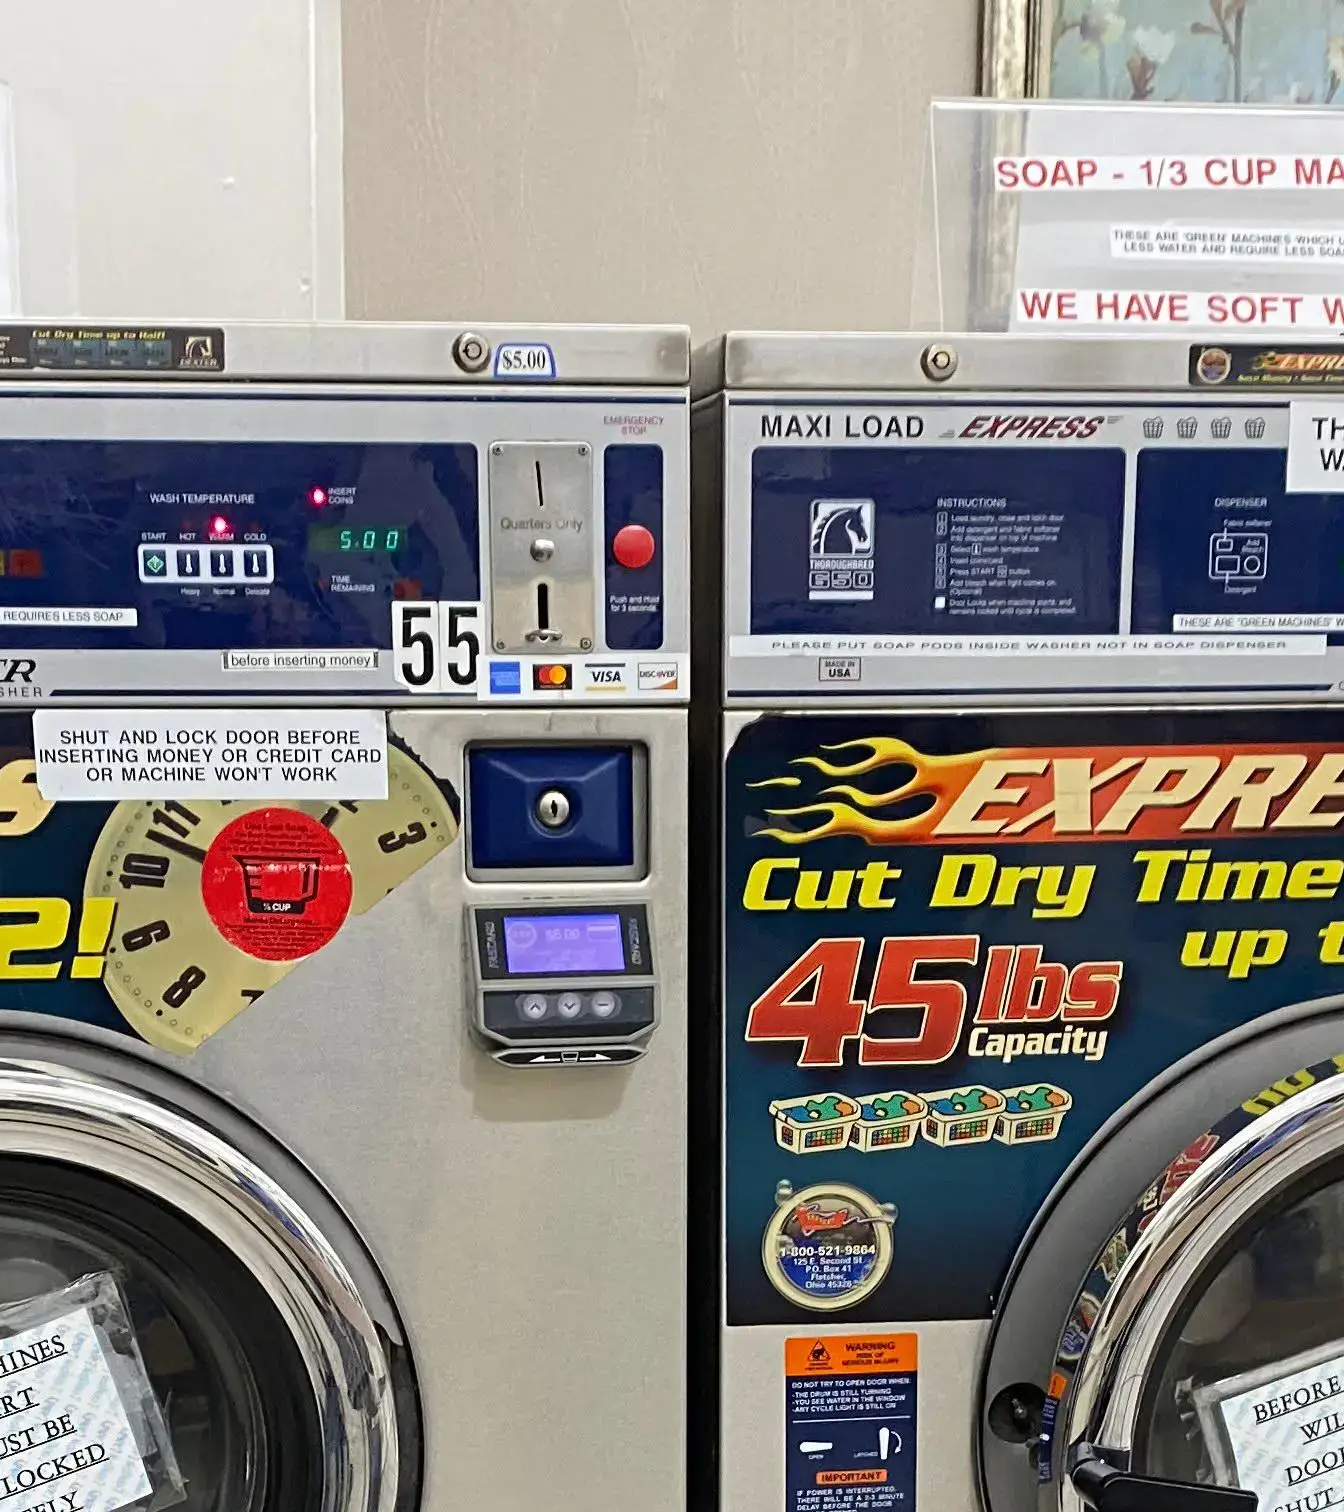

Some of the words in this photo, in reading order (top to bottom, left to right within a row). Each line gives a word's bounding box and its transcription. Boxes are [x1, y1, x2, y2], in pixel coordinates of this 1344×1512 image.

[995, 159, 1098, 189] SOAP
[1140, 160, 1188, 188] 1/3
[1204, 158, 1277, 186] CUP
[1123, 241, 1154, 253] LESS
[1158, 242, 1197, 254] WATER
[1201, 243, 1226, 255] AND
[1229, 244, 1279, 256] REQUIRE
[1284, 245, 1315, 257] LESS
[1020, 291, 1078, 320] WE
[1096, 293, 1189, 322] HAVE
[1207, 295, 1304, 324] SOFT
[502, 350, 546, 370] $5.00
[761, 414, 831, 438] MAXI
[845, 415, 924, 439] LOAD
[957, 415, 1105, 439] EXPRESS
[149, 493, 180, 504] WASH
[182, 493, 255, 505] TEMPERATURE
[500, 517, 552, 531] Quarters
[557, 518, 583, 533] Only
[402, 606, 480, 686] 55
[771, 641, 832, 650] PLEASE
[837, 641, 866, 650] PUT
[872, 641, 915, 650] SOAP
[920, 641, 963, 650] PODS
[968, 641, 1020, 650] INSIDE
[1026, 642, 1091, 650] WASHER
[1096, 641, 1127, 650] NOT
[1132, 641, 1148, 649] IN
[1153, 641, 1195, 649] SOAP
[1199, 641, 1286, 649] DISPENSER
[231, 654, 270, 667] before
[274, 654, 326, 669] inserting
[330, 656, 371, 669] money
[591, 670, 622, 683] VISA
[60, 729, 109, 745] SHUT
[119, 729, 158, 745] AND
[165, 729, 217, 745] LOCK
[226, 729, 279, 745] DOOR
[287, 730, 361, 745] BEFORE
[39, 747, 139, 764] INSERTING
[147, 748, 213, 763] MONEY
[221, 748, 248, 763] OR
[256, 748, 323, 764] CREDIT
[331, 748, 382, 763] CARD
[86, 767, 113, 782] OR
[121, 766, 206, 782] MACHINE
[214, 766, 273, 782] WON'T
[281, 766, 337, 782] WORK
[120, 853, 170, 890] 10
[742, 857, 903, 911] Cut
[929, 854, 1097, 919] Dry
[1133, 849, 1344, 903] Time
[1181, 928, 1289, 979] up
[745, 934, 980, 1067] 45
[973, 945, 1124, 1024] lbs
[968, 1025, 1109, 1064] Capacity
[1253, 1374, 1343, 1425] BEFORE
[44, 1414, 77, 1443] BE
[1, 1442, 108, 1495] LOCKED
